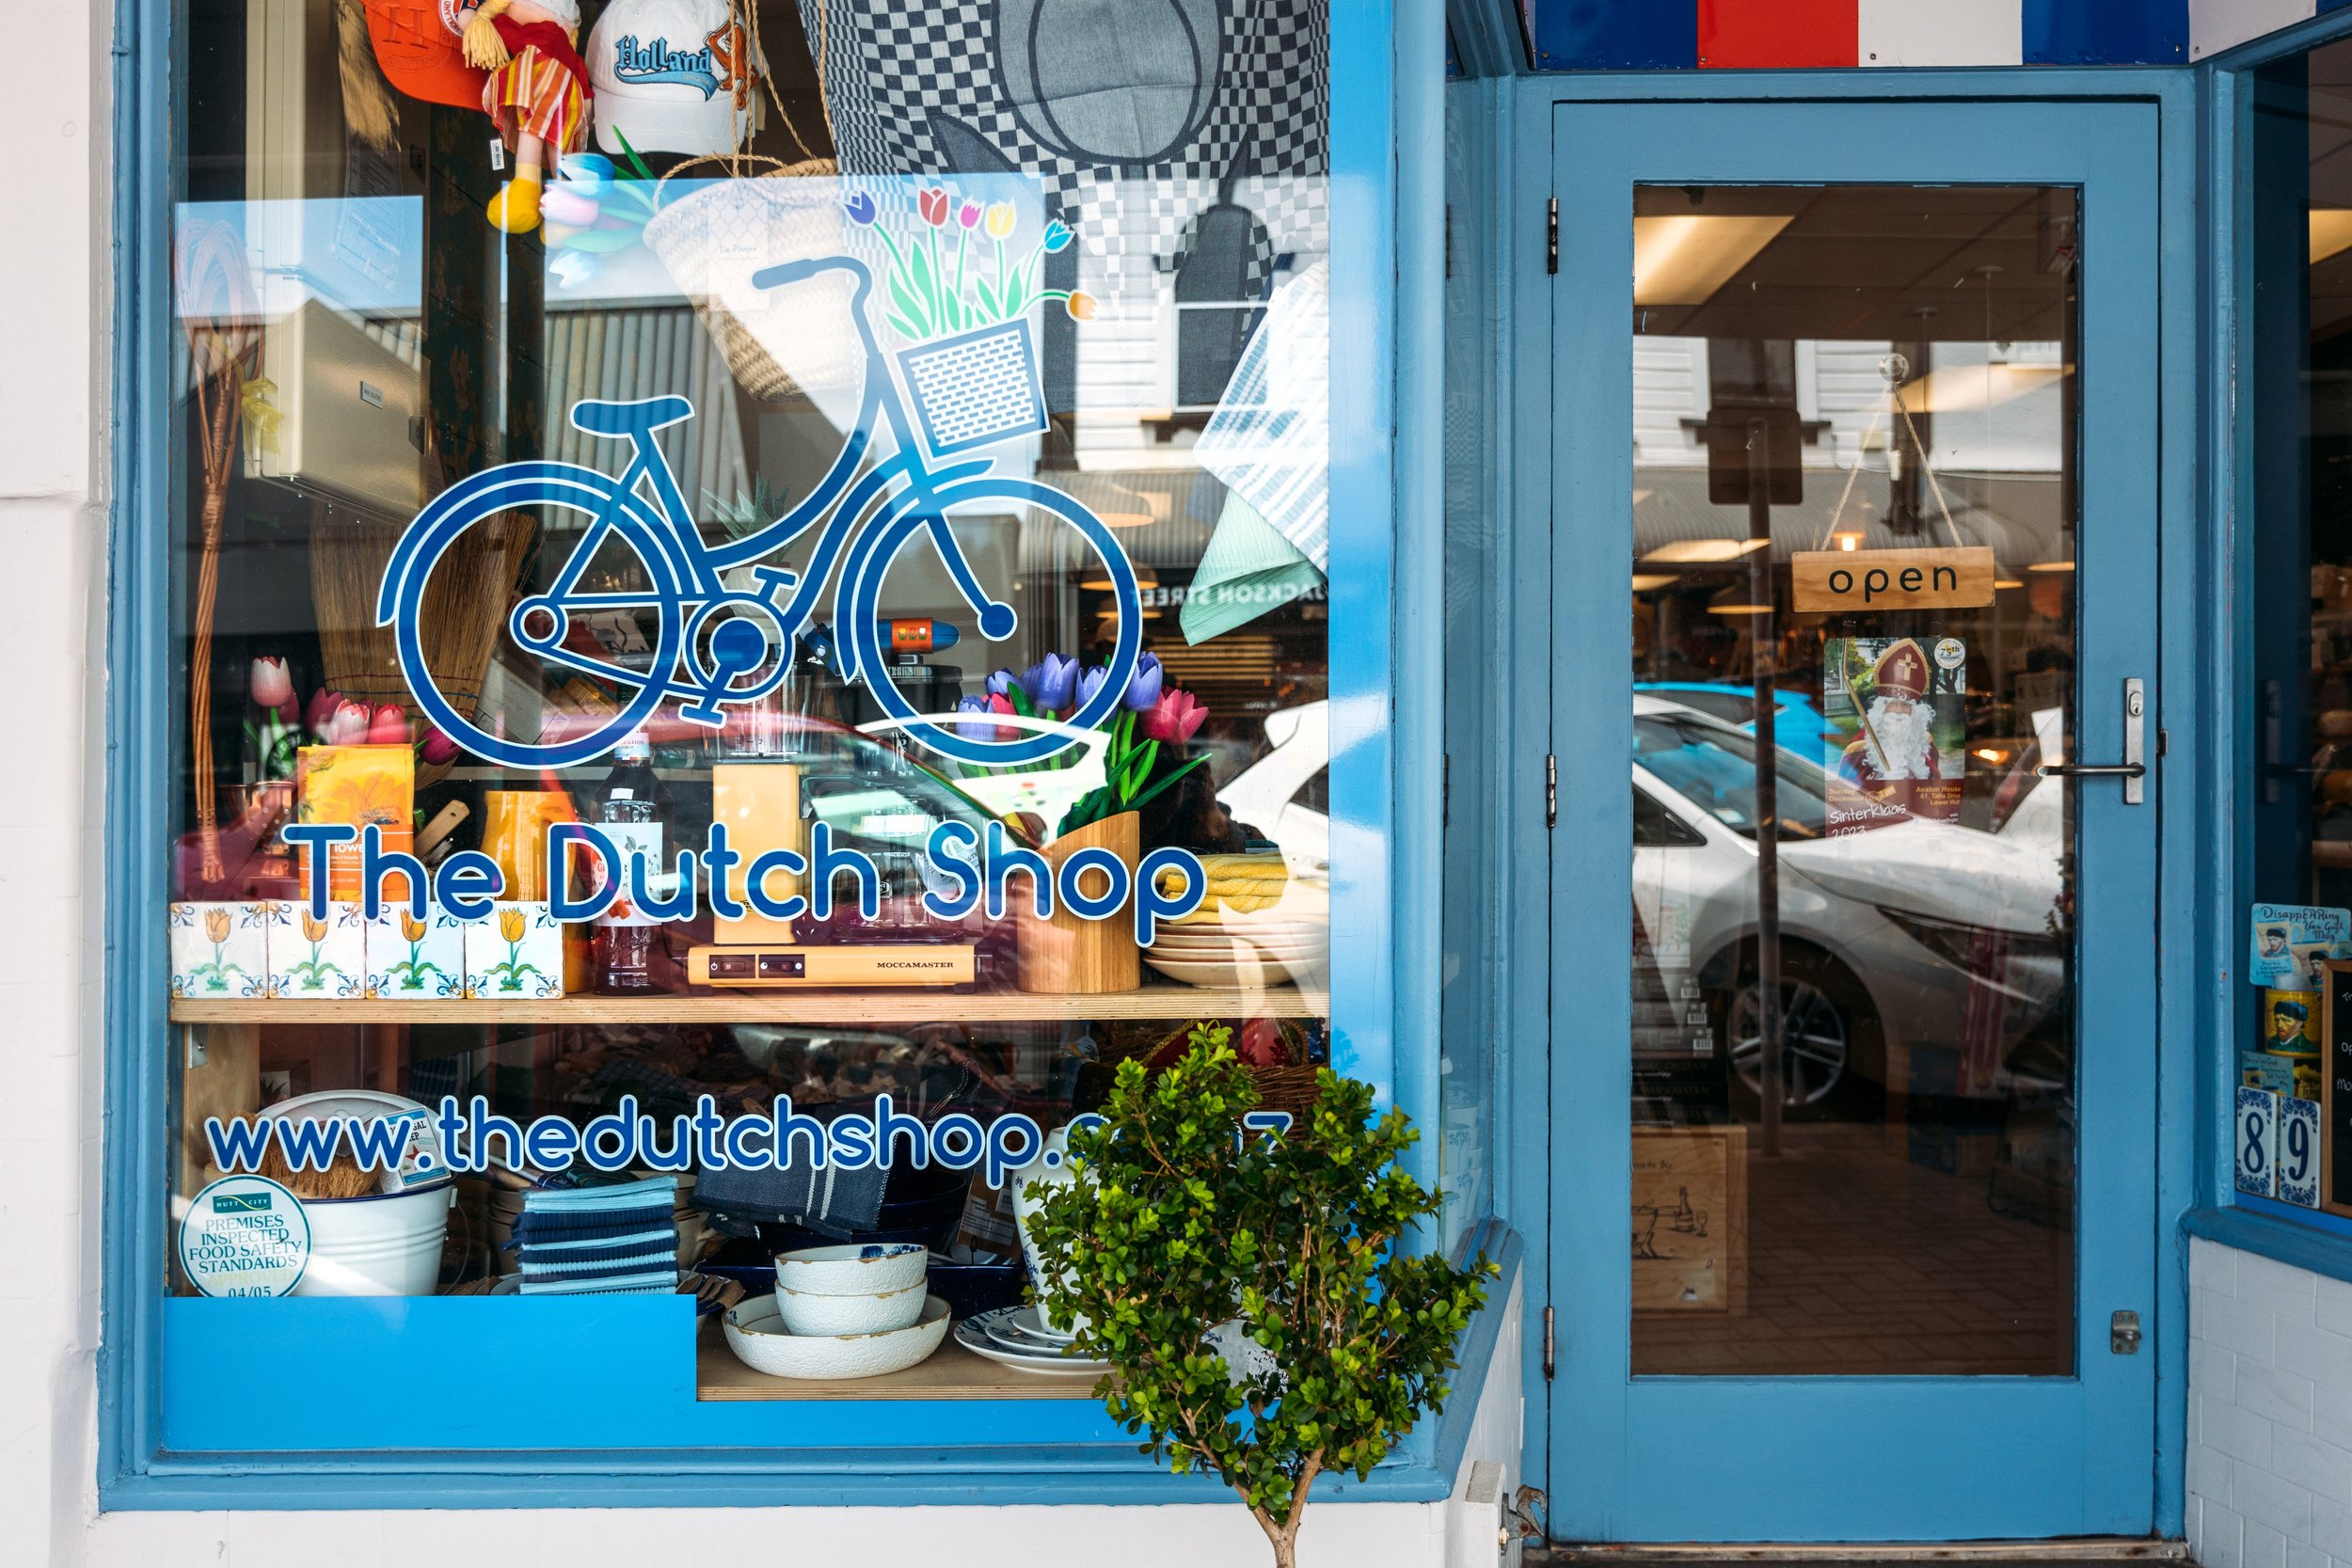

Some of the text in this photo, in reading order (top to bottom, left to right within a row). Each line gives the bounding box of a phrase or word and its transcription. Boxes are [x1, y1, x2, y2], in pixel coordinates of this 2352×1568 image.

[615, 35, 712, 72] Holland
[1828, 566, 1957, 603] open
[1830, 803, 1907, 825] Sinterklaas
[1832, 825, 1866, 841] 2023
[281, 821, 1207, 948] The Dutch Shop
[2244, 1112, 2309, 1180] 8 9
[206, 1214, 284, 1231] PREMISES
[201, 1227, 290, 1245] INSPECTED
[189, 1241, 302, 1260] FOOD SAFETY
[199, 1255, 297, 1274] STANDARDS
[207, 1270, 294, 1288] APPROVED
[229, 1286, 271, 1297] 04/05
